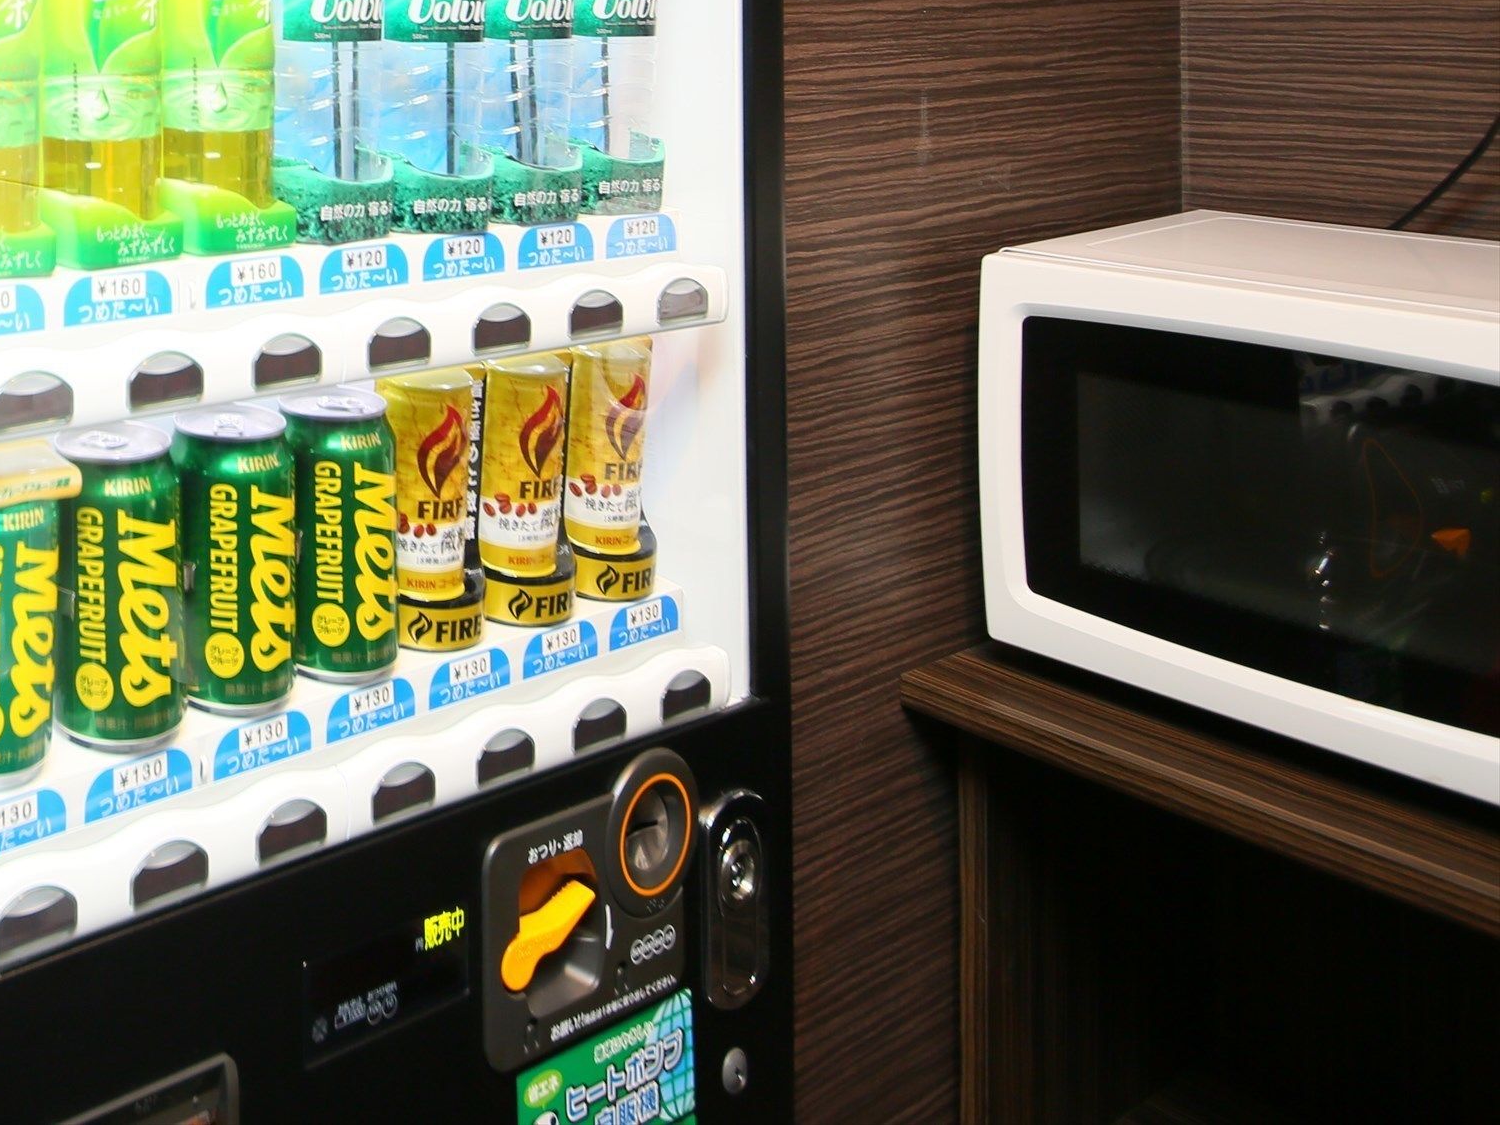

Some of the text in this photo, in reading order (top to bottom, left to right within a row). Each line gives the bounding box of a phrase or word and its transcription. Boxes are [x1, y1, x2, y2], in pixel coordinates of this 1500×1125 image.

[514, 189, 558, 207] 自然の力
[599, 179, 640, 195] 自然の力
[320, 202, 366, 222] 自然の力
[413, 197, 462, 215] 自然の力
[236, 225, 288, 243] みずみずしく
[539, 228, 573, 247] ¥120
[625, 218, 658, 237] ¥120
[117, 229, 175, 257] みずみずしく
[446, 238, 481, 257] ¥120
[346, 249, 383, 268] ¥120
[236, 261, 277, 282] ¥160
[97, 277, 141, 296] ¥160
[340, 433, 381, 450] KIRIN
[237, 453, 280, 474] KIRIN
[104, 478, 152, 497] KIRIN
[2, 509, 44, 531] KIRIN
[314, 460, 343, 604] GRAPEFRUIT
[209, 483, 238, 634] GRAPEFRUIT
[354, 462, 399, 641] Mets
[77, 506, 107, 664] GRAPEFRUIT
[250, 484, 296, 672] Mets
[117, 507, 178, 708] Mets
[630, 604, 659, 627] ¥130
[9, 540, 59, 738] Mets
[545, 628, 577, 650] ¥130
[453, 655, 489, 681] ¥130
[353, 686, 390, 711] ¥130
[243, 720, 285, 747] ¥130
[118, 760, 164, 791] ¥130
[566, 1028, 682, 1122] ヒートポンプ
